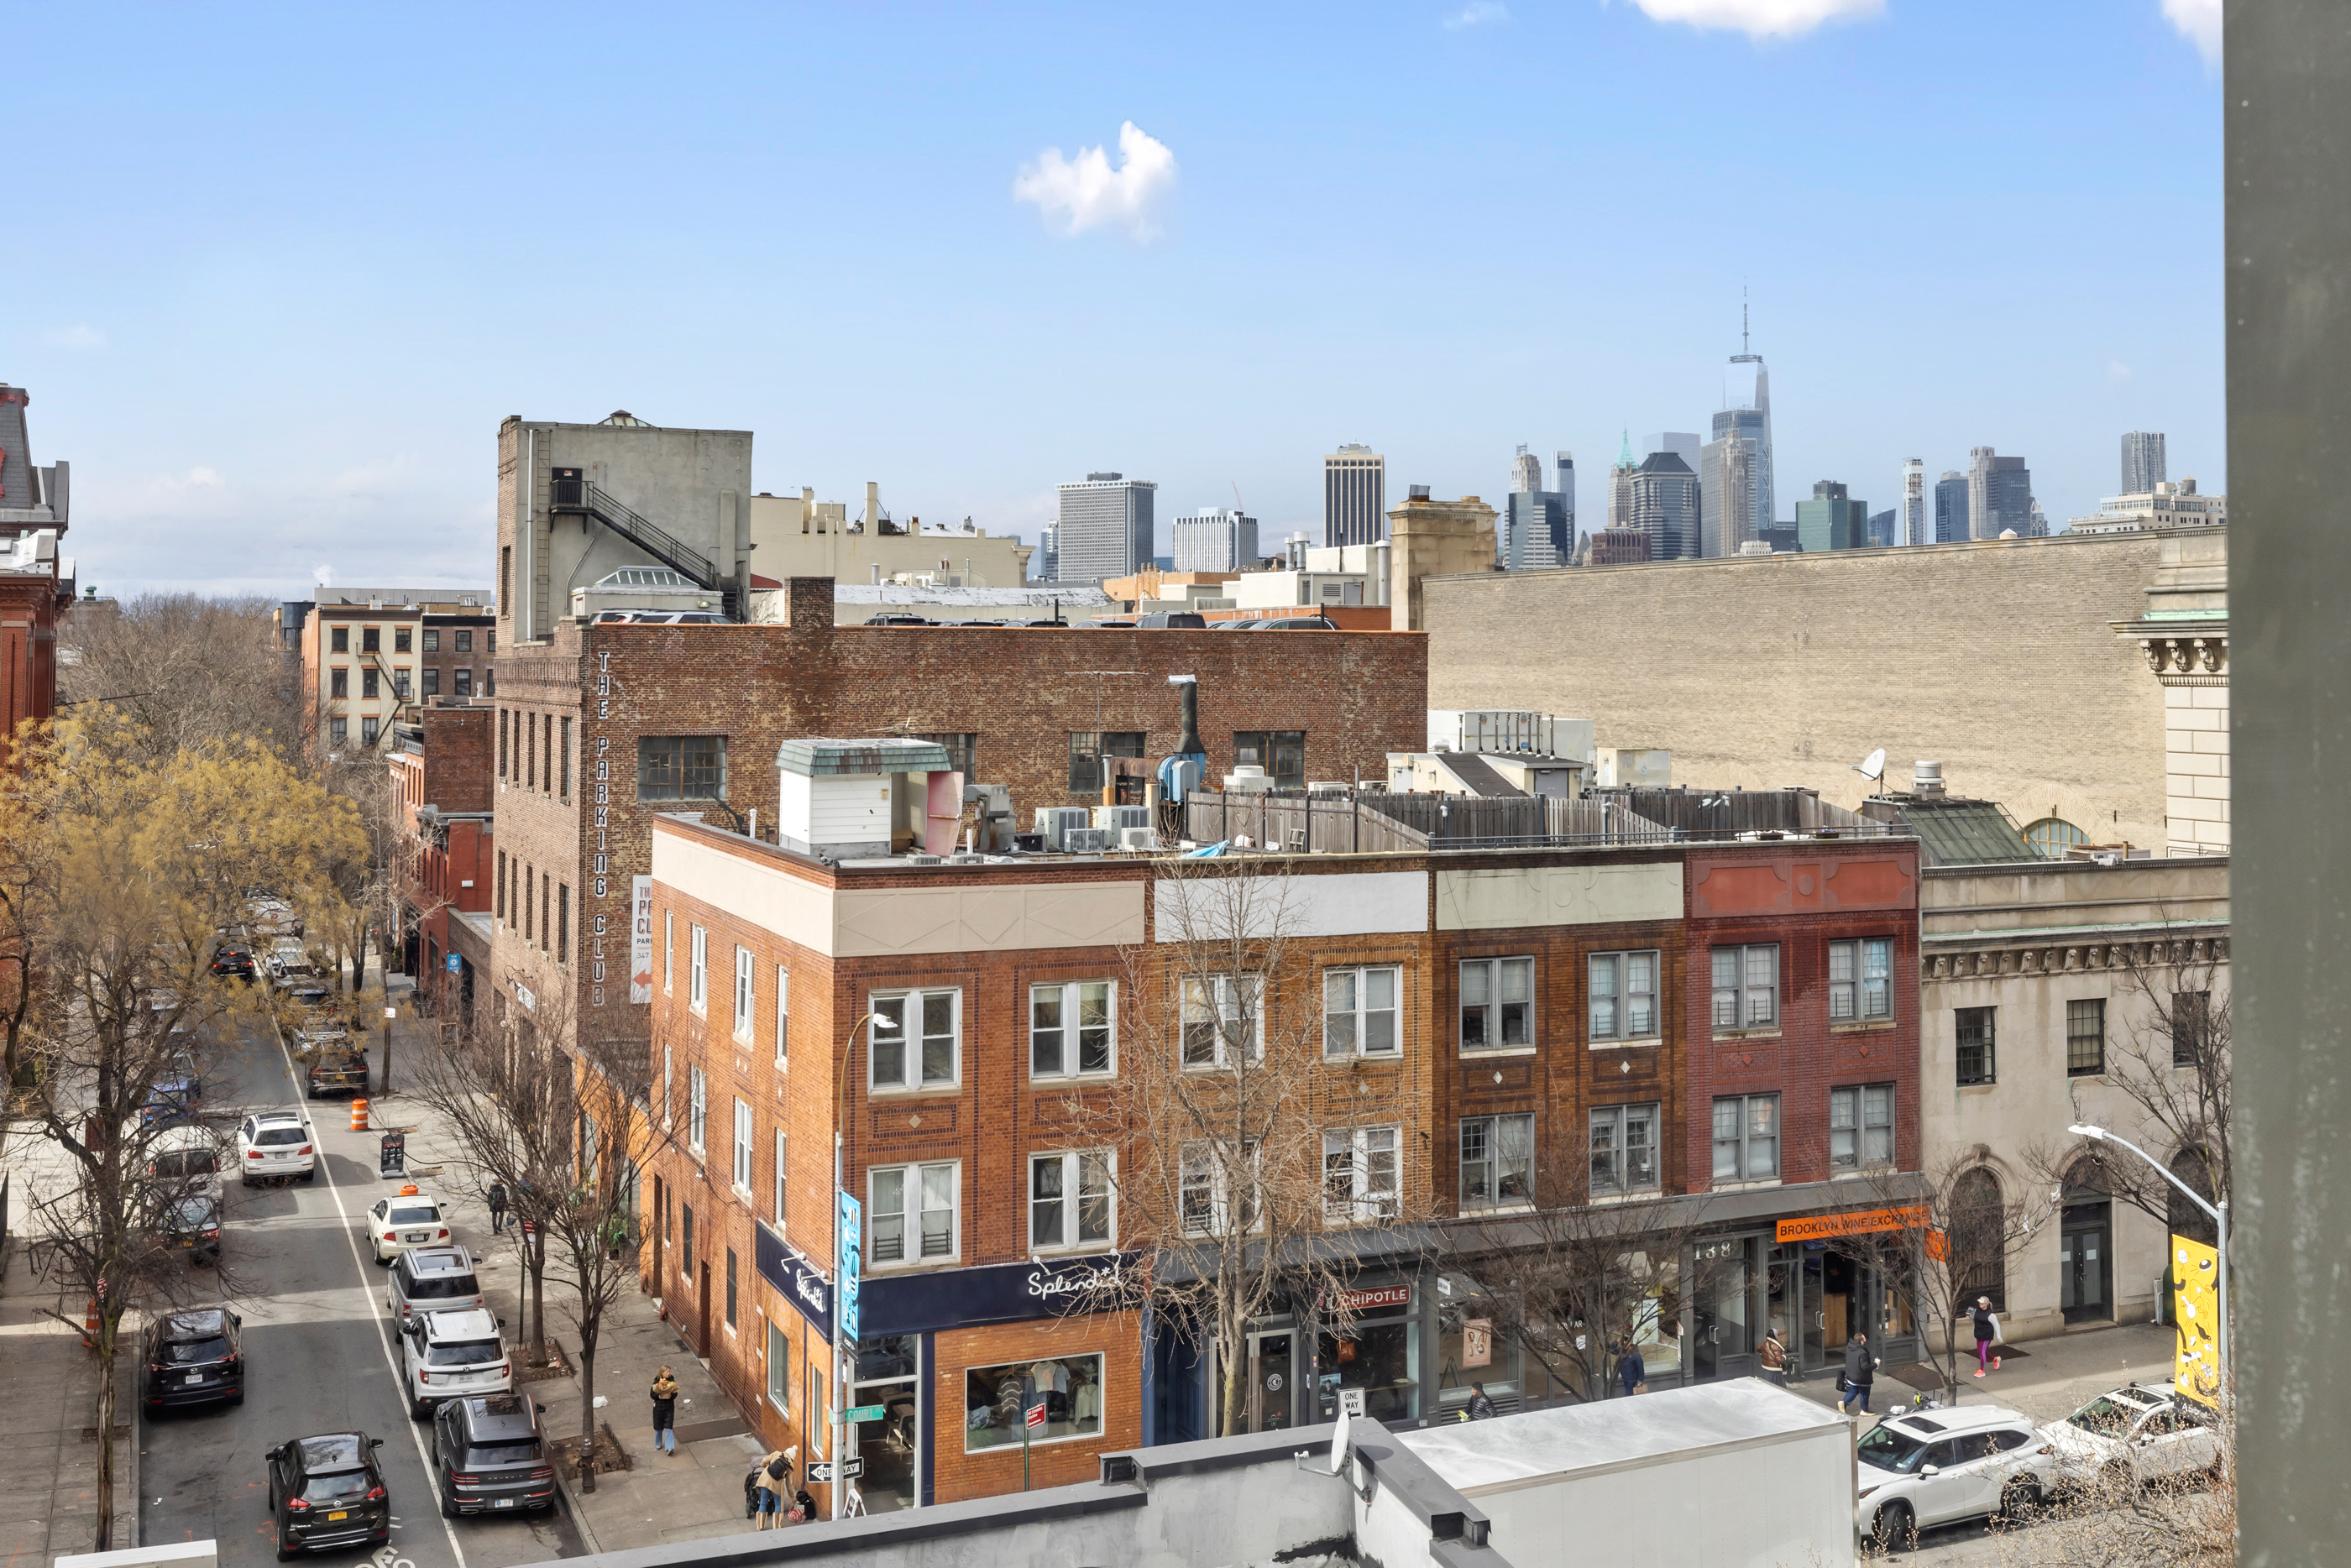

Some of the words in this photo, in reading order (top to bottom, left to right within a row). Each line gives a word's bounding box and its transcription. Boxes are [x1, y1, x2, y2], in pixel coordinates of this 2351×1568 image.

[598, 651, 610, 719] THE
[639, 886, 652, 898] TH
[592, 914, 606, 1006] CLUB
[1780, 1221, 1839, 1236] BROOKLYN
[1841, 1216, 1867, 1231] WINE
[1871, 1212, 1927, 1227] EXCHANGE
[1694, 1241, 1730, 1260] 138
[1343, 1288, 1407, 1307] CHIPOTLE
[848, 1408, 873, 1421] COURT
[1345, 1401, 1359, 1409] WAY
[816, 1468, 832, 1477] ONE
